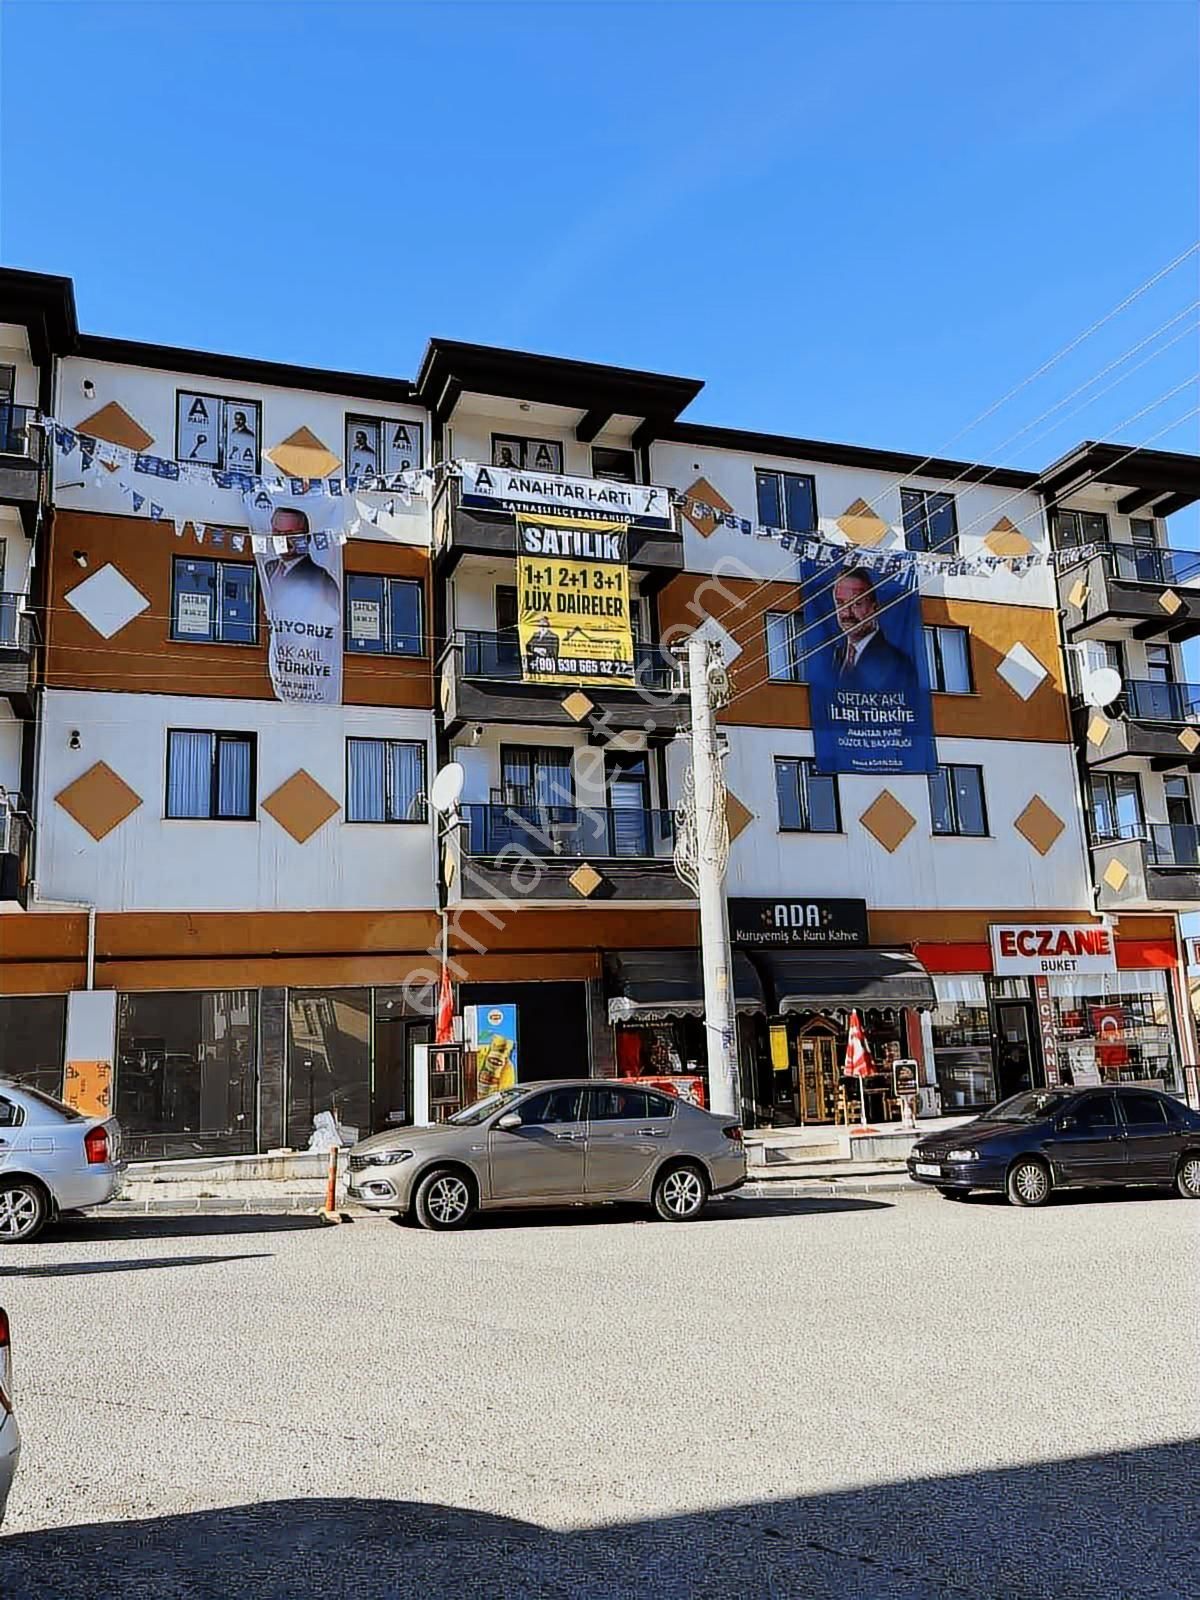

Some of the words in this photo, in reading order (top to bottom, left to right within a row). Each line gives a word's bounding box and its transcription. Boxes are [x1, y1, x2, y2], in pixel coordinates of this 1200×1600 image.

[475, 468, 493, 487] A
[508, 477, 584, 500] ANAHTAR
[525, 527, 621, 560] SATILIK
[525, 564, 552, 586] 1+1
[559, 567, 588, 588] 2+1
[593, 570, 623, 591] 3+1
[525, 586, 552, 612] LÜX
[557, 589, 623, 617] DAİRELER
[276, 659, 332, 677] TÜRKİYE
[837, 692, 878, 706] ORTAK
[831, 703, 860, 721] İLERİ
[775, 905, 820, 927] ADA
[736, 930, 789, 943] Kuruyemiş
[792, 930, 800, 940] &
[803, 930, 825, 941] Kuru
[829, 929, 858, 941] Kahve
[1000, 930, 1111, 957] ECZANE
[1041, 960, 1077, 972] BUKET
